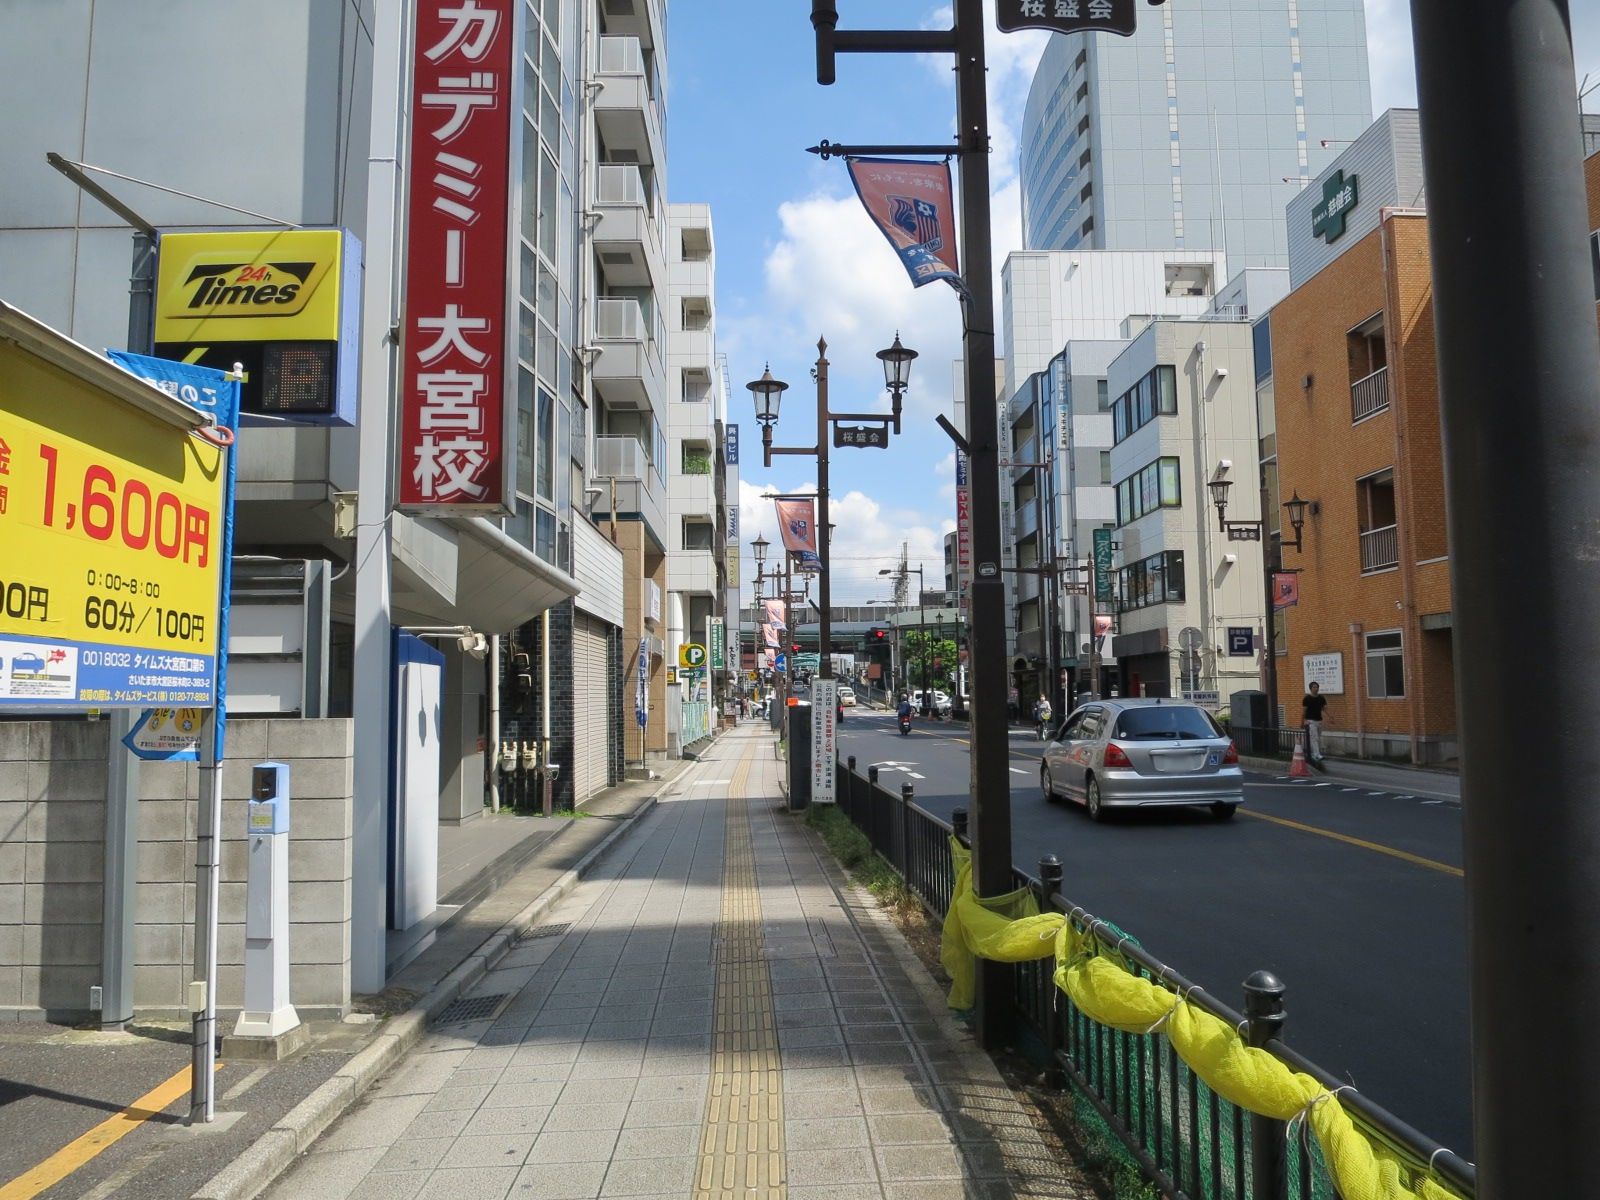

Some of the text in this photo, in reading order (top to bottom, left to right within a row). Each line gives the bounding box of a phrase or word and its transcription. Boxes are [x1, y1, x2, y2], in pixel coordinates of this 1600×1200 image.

[1019, 0, 1113, 20] 桜盛会
[412, 0, 502, 499] カデミー大宮校
[183, 262, 317, 309] Times
[842, 432, 880, 443] 桜盛会
[40, 443, 210, 569] 1,600円
[0, 579, 49, 623] 0円
[1233, 636, 1248, 650] P
[83, 650, 131, 668] 0018032
[690, 648, 703, 664] P
